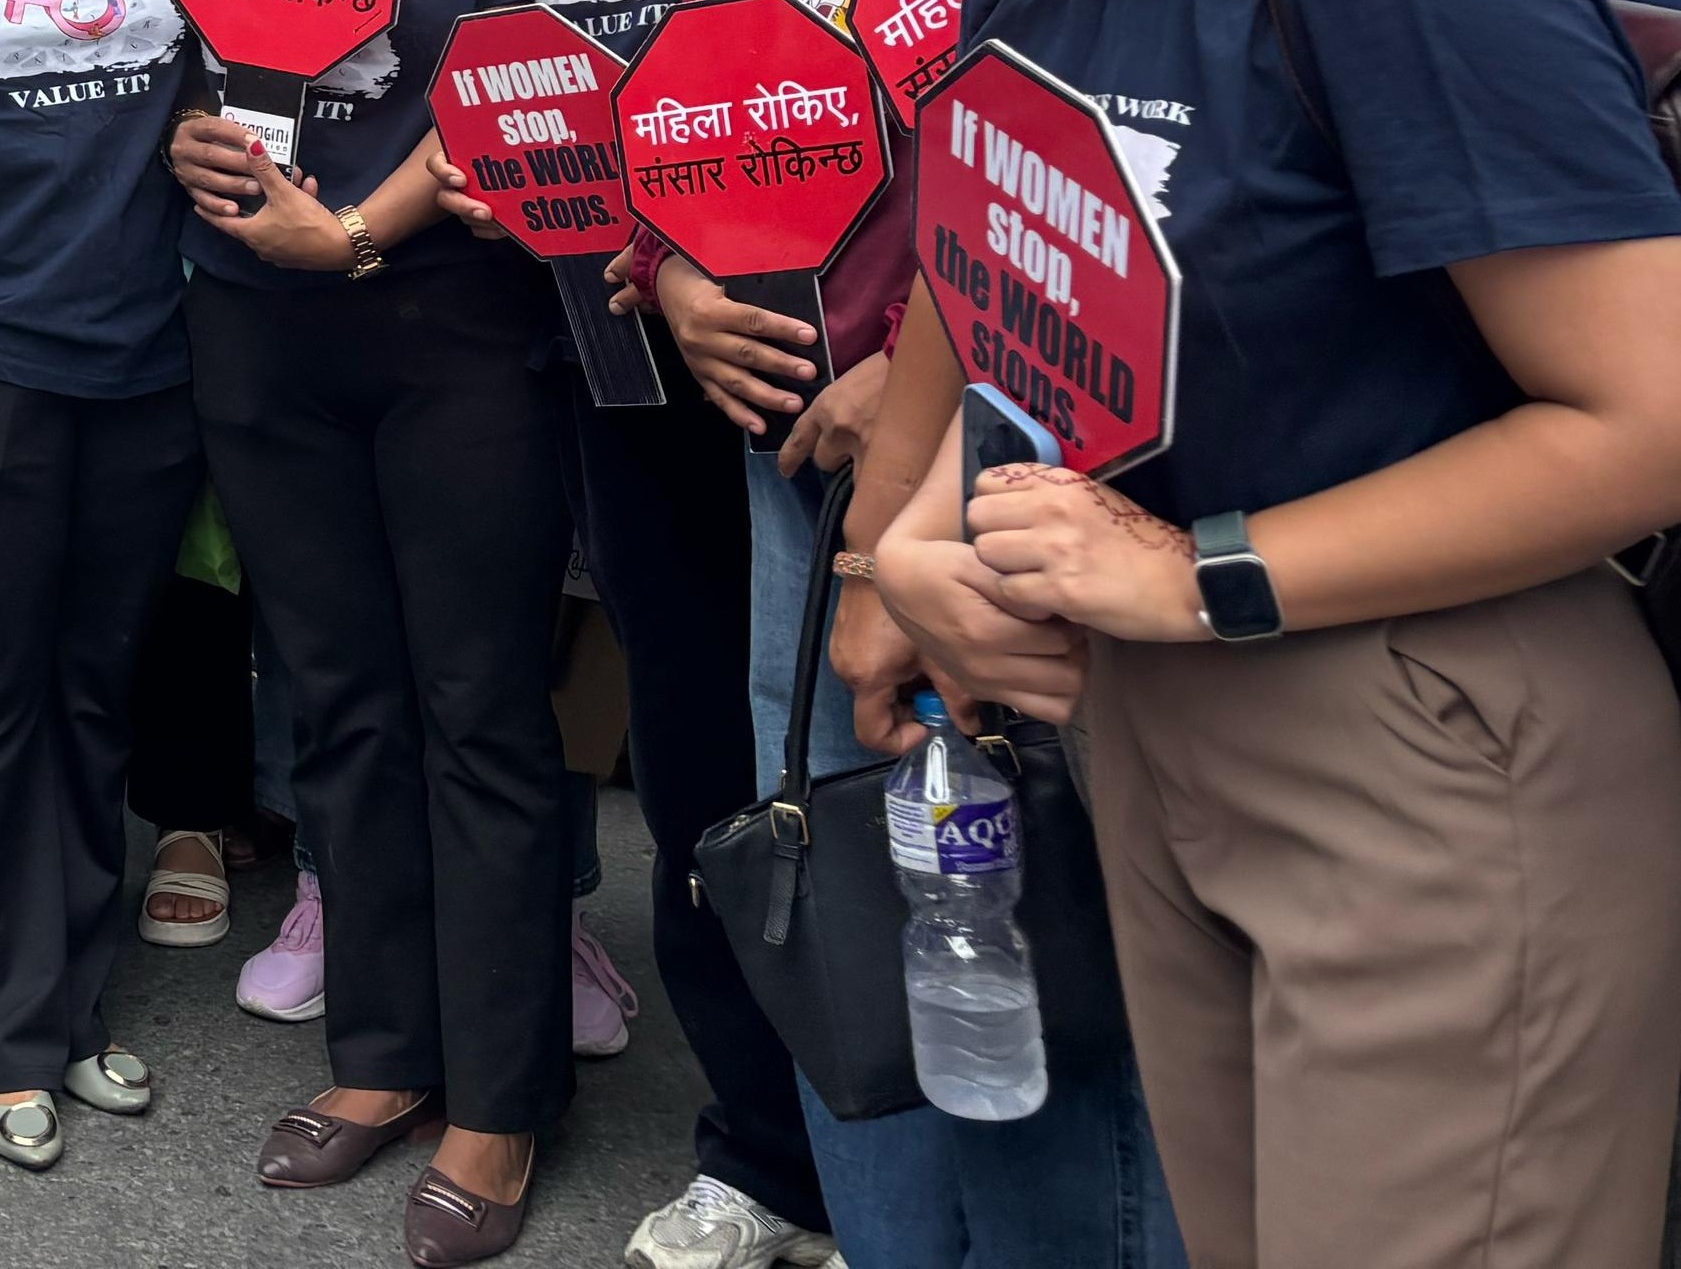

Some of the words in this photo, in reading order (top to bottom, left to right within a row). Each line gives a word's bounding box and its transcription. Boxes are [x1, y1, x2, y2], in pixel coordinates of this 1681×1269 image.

[585, 11, 633, 37] LUE
[8, 80, 106, 109] VALUE
[114, 73, 151, 96] IT!
[452, 69, 484, 107] If
[477, 52, 598, 105] WOMEN
[313, 100, 354, 121] IT!
[497, 106, 578, 147] stop,
[630, 97, 732, 146] महिला
[743, 80, 859, 132] रोकिए,
[471, 153, 526, 193] the
[524, 141, 620, 187] WORL
[634, 156, 726, 199] संसार
[736, 137, 863, 189] रोकिन्छ
[951, 99, 979, 168] If
[984, 119, 1130, 279] WOMEN
[521, 192, 619, 233] stops.
[987, 201, 1080, 317] stop,
[934, 223, 990, 311] the
[1000, 269, 1135, 425] WORLD
[971, 320, 1085, 451] stops.
